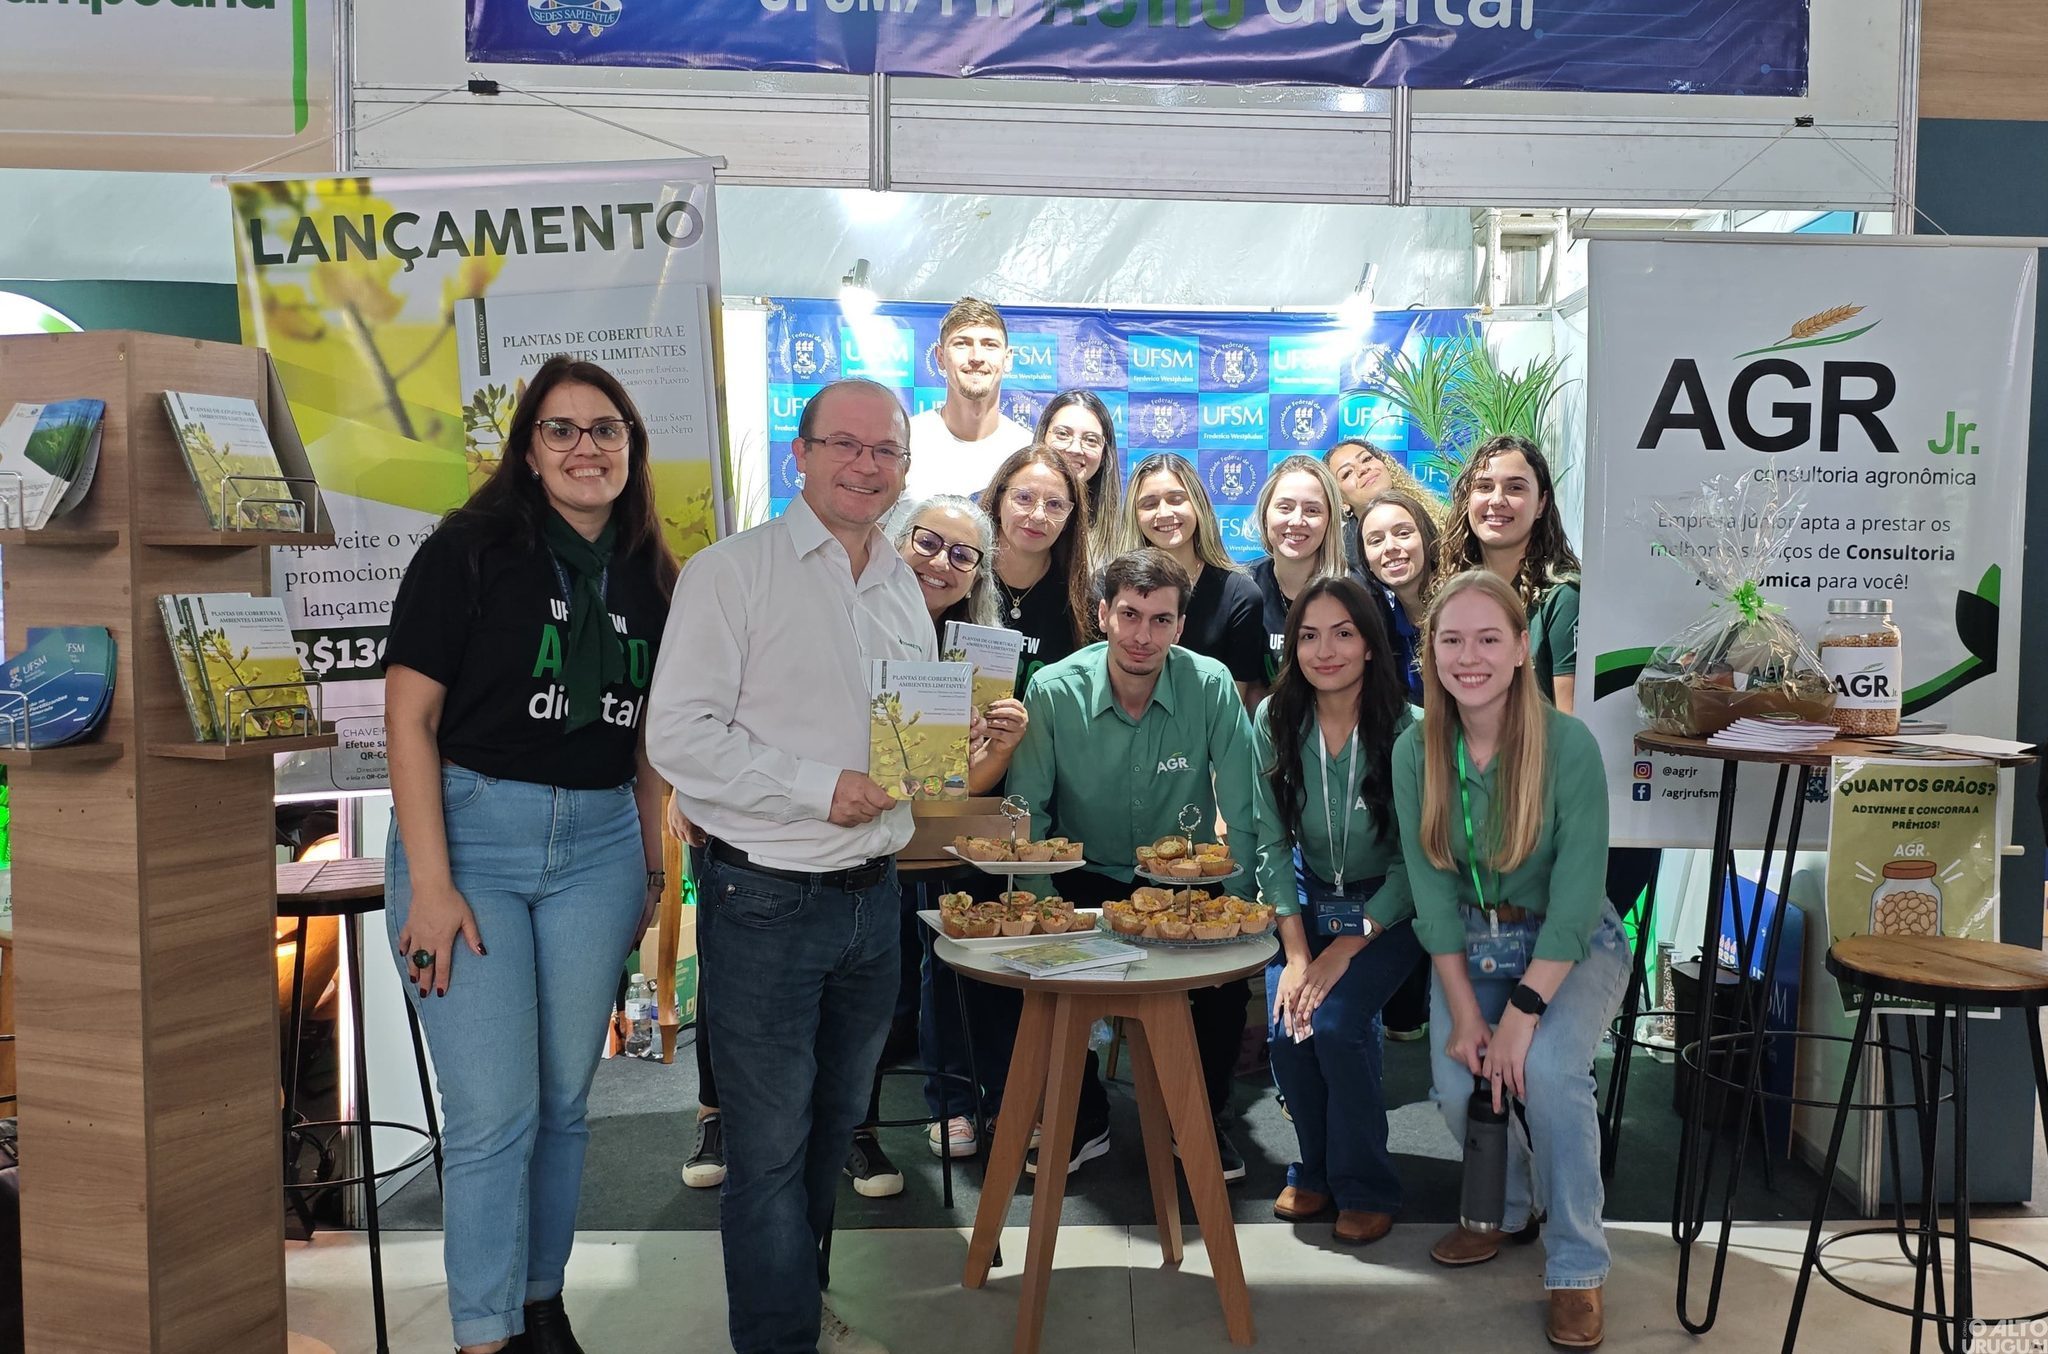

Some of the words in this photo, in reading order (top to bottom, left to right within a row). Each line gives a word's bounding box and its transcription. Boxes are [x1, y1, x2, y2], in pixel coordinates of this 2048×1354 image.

[533, 10, 563, 22] SEDES
[250, 200, 704, 273] LANÇAMENTO
[503, 332, 562, 349] PLANTAS
[566, 331, 585, 344] DE
[588, 326, 673, 344] COBERTURA
[677, 325, 686, 337] E
[602, 344, 687, 362] LIMITANTES
[1132, 348, 1194, 369] UFSM
[1636, 357, 1900, 453] AGR
[1203, 404, 1264, 426] UFSM
[671, 424, 693, 435] NETO
[1203, 432, 1230, 440] Frederico
[1230, 432, 1264, 441] Westphalen
[1927, 410, 1980, 456] Jr.
[1220, 454, 1243, 463] Federal
[1753, 465, 1858, 484] consultoria
[1865, 467, 1976, 489] agronômica
[1800, 515, 1840, 534] apta
[1845, 518, 1856, 531] a
[1861, 516, 1926, 535] prestar
[1930, 519, 1951, 532] os
[387, 532, 400, 546] o
[1818, 543, 1841, 560] de
[1846, 544, 1955, 561] Consultoria
[1817, 575, 1858, 592] para
[1863, 573, 1908, 590] você!
[22, 655, 48, 675] UFSM
[1834, 674, 1890, 698] AGR
[343, 727, 380, 738] CHAVE
[345, 740, 375, 749] Efetue
[1157, 756, 1189, 775] AGR
[1662, 766, 1698, 778] @agrjr
[1839, 778, 1928, 797] QUANTOS
[1931, 776, 1996, 797] GRÃOS?
[1852, 804, 1907, 815] ADIVINHE
[1908, 806, 1916, 815] E
[1916, 806, 1971, 816] CONCORRA
[1971, 804, 1980, 814] A
[1891, 818, 1941, 830] PRÊMIOS!
[1893, 842, 1926, 857] AGR
